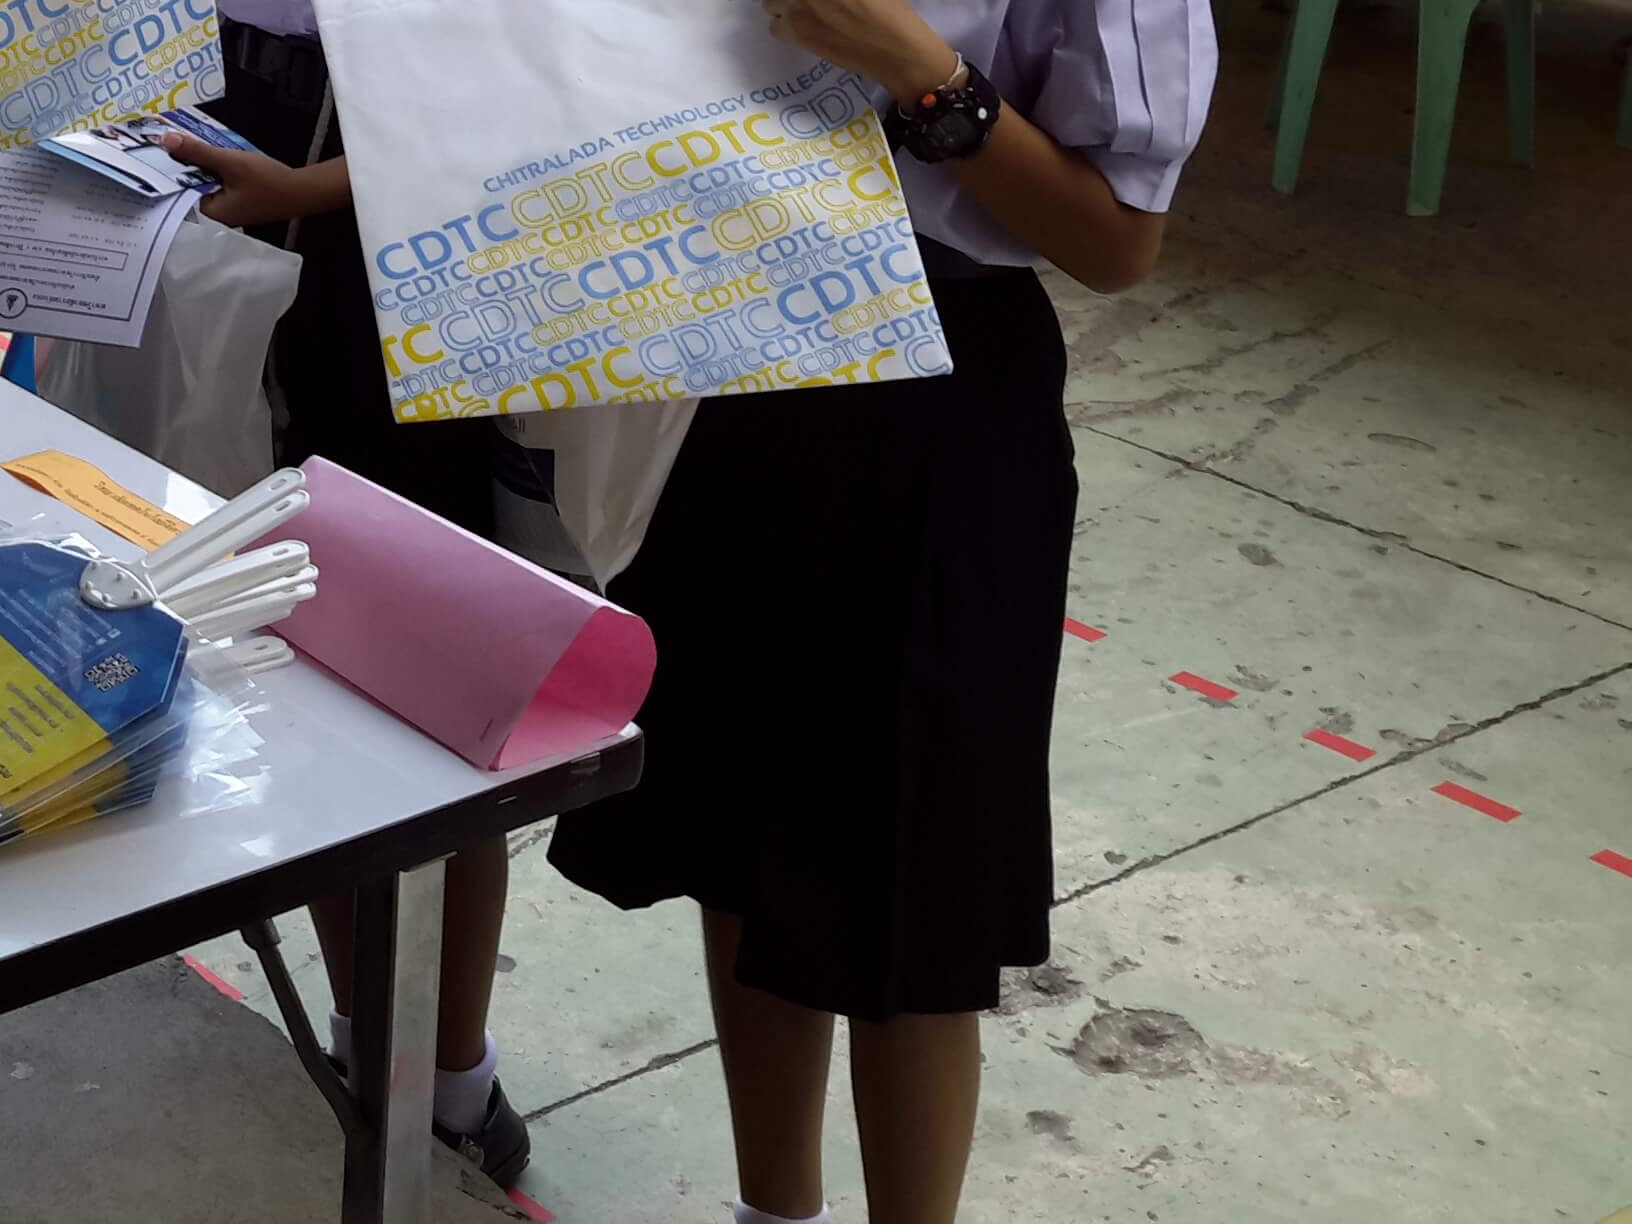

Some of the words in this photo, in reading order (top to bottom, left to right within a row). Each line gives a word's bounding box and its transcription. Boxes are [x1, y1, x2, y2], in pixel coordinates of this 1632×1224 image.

[42, 19, 106, 65] CDTC
[89, 58, 152, 103] CDTC
[373, 198, 522, 282] CDTC
[509, 146, 657, 232] CDTC
[645, 101, 786, 184] CDTC
[481, 133, 614, 194] CHITRALADA
[614, 87, 747, 150] TECHNOLOGY
[393, 258, 473, 303] CDTC
[540, 203, 619, 248] CDTC
[687, 151, 765, 195] CDTC
[399, 279, 481, 327] CDTC
[474, 254, 553, 298] CDTC
[619, 200, 696, 244] CDTC
[767, 151, 841, 195] CDTC
[437, 269, 587, 354] CDTC
[577, 220, 722, 302] CDTC
[709, 168, 858, 253] CDTC
[457, 329, 539, 375] CDTC
[606, 274, 685, 319] CDTC
[755, 219, 836, 266] CDTC
[470, 348, 554, 397] CDTC
[546, 322, 625, 367] CDTC
[690, 268, 769, 315] CDTC
[840, 215, 915, 258] CDTC
[636, 291, 787, 379] CDTC
[774, 238, 925, 326] CDTC
[758, 317, 839, 363] CDTC
[796, 328, 879, 378] CDTC
